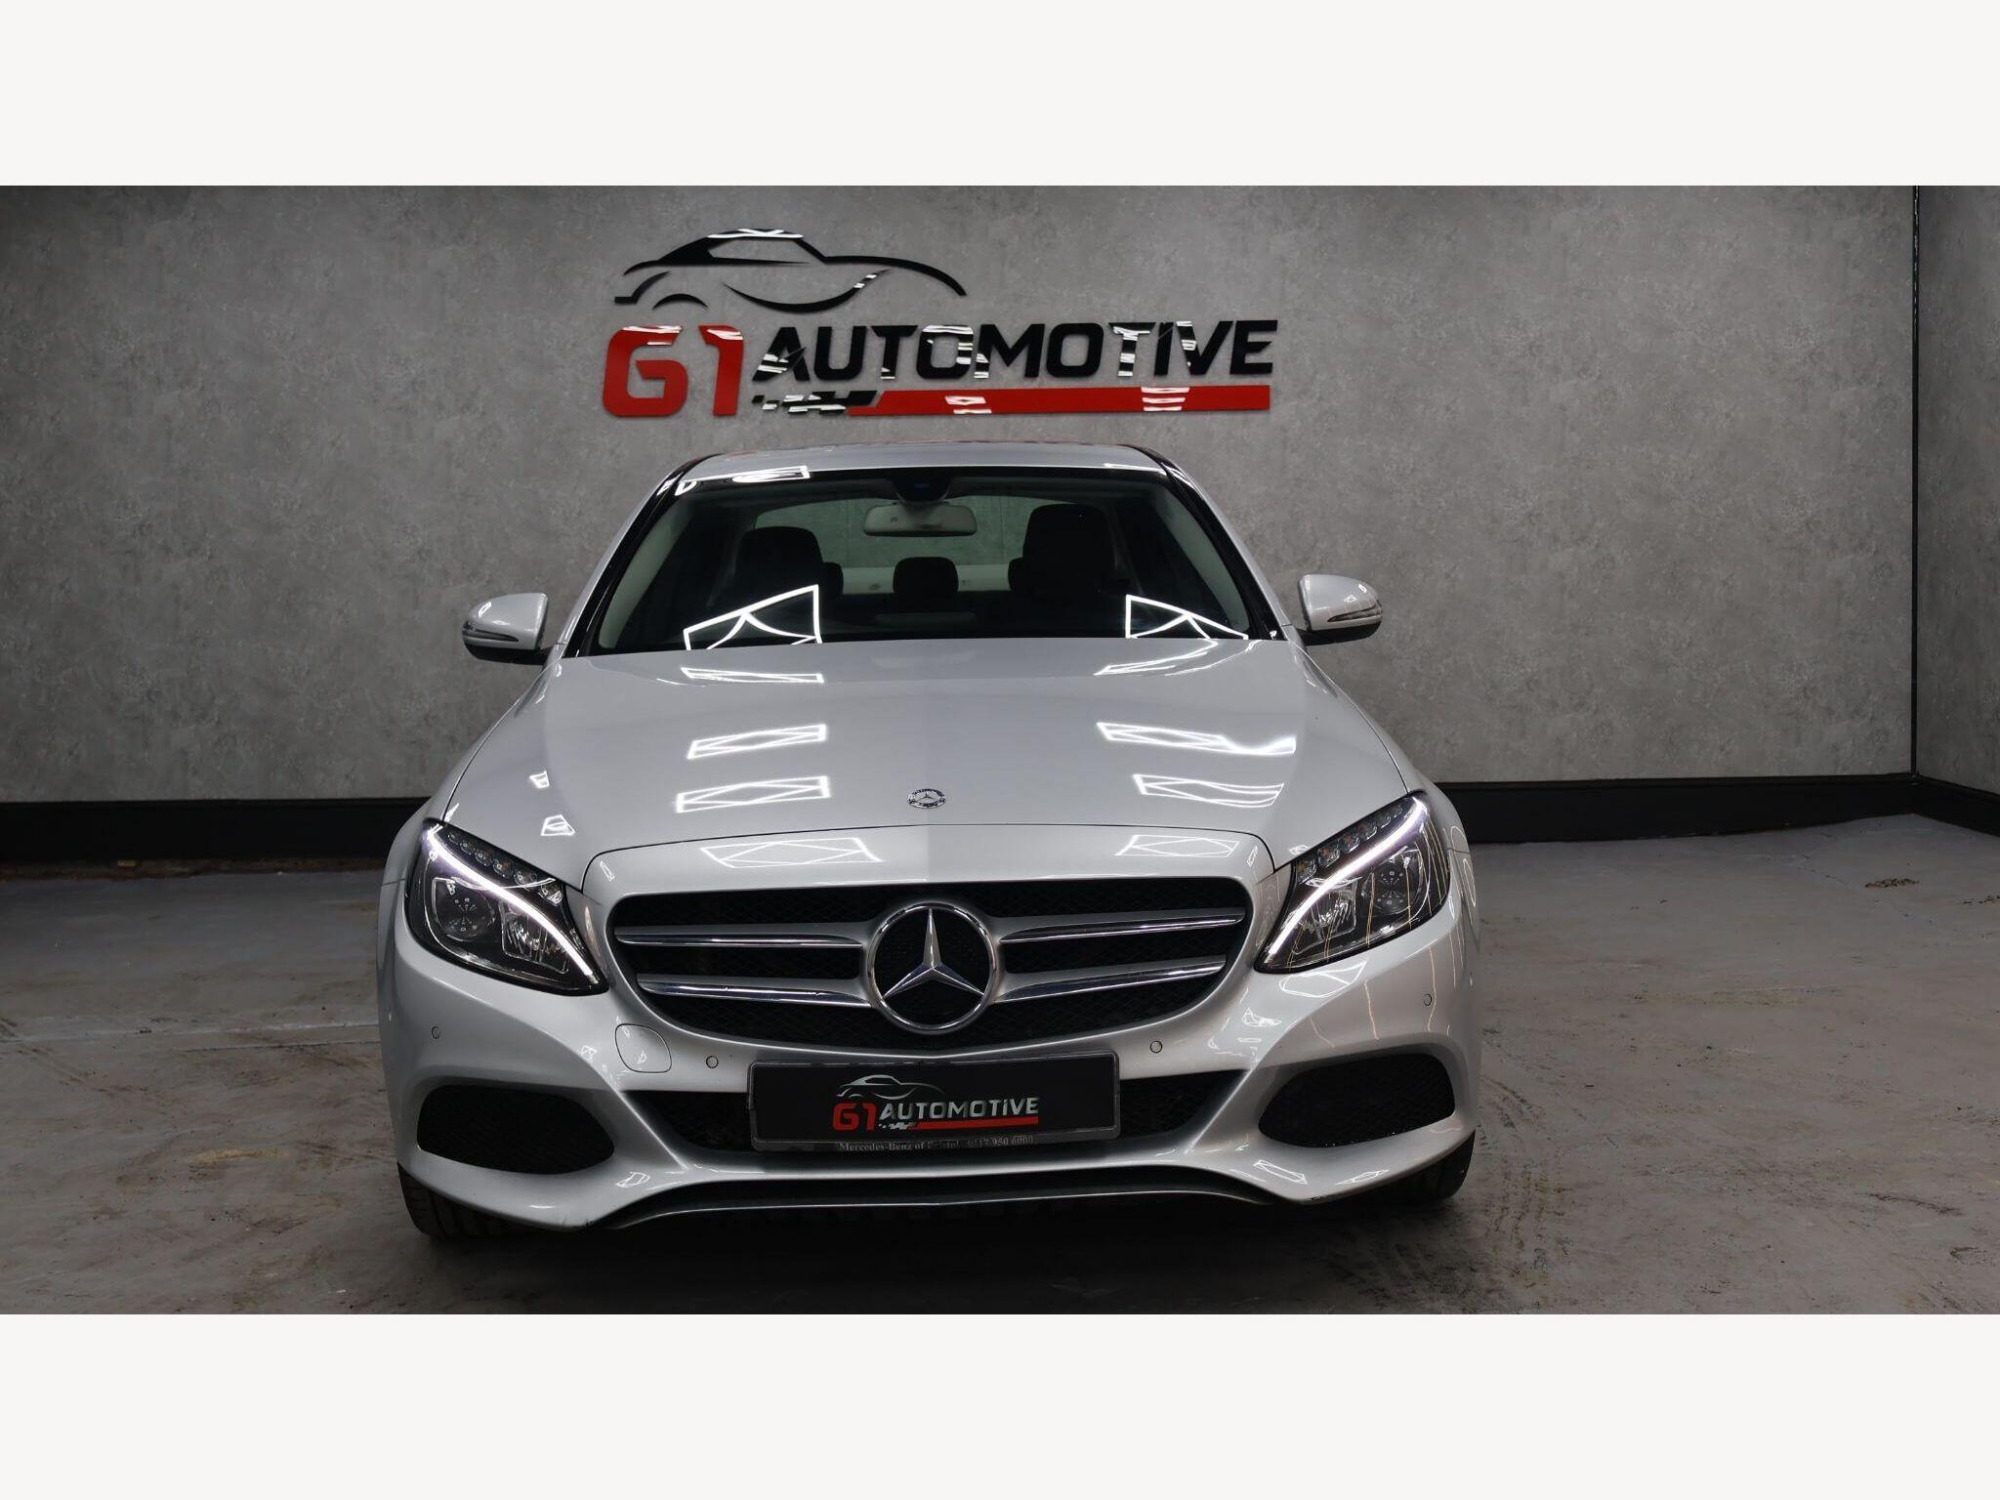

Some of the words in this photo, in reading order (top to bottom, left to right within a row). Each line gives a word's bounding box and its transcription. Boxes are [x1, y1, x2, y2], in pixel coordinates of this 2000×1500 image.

[602, 324, 745, 417] G1
[752, 319, 1278, 382] AUTOMOTIVE
[832, 1102, 877, 1131] G1
[879, 1097, 1039, 1121] AUTOMOTIVE
[838, 1141, 912, 1151] Mercedes-Benz
[914, 1140, 925, 1150] of
